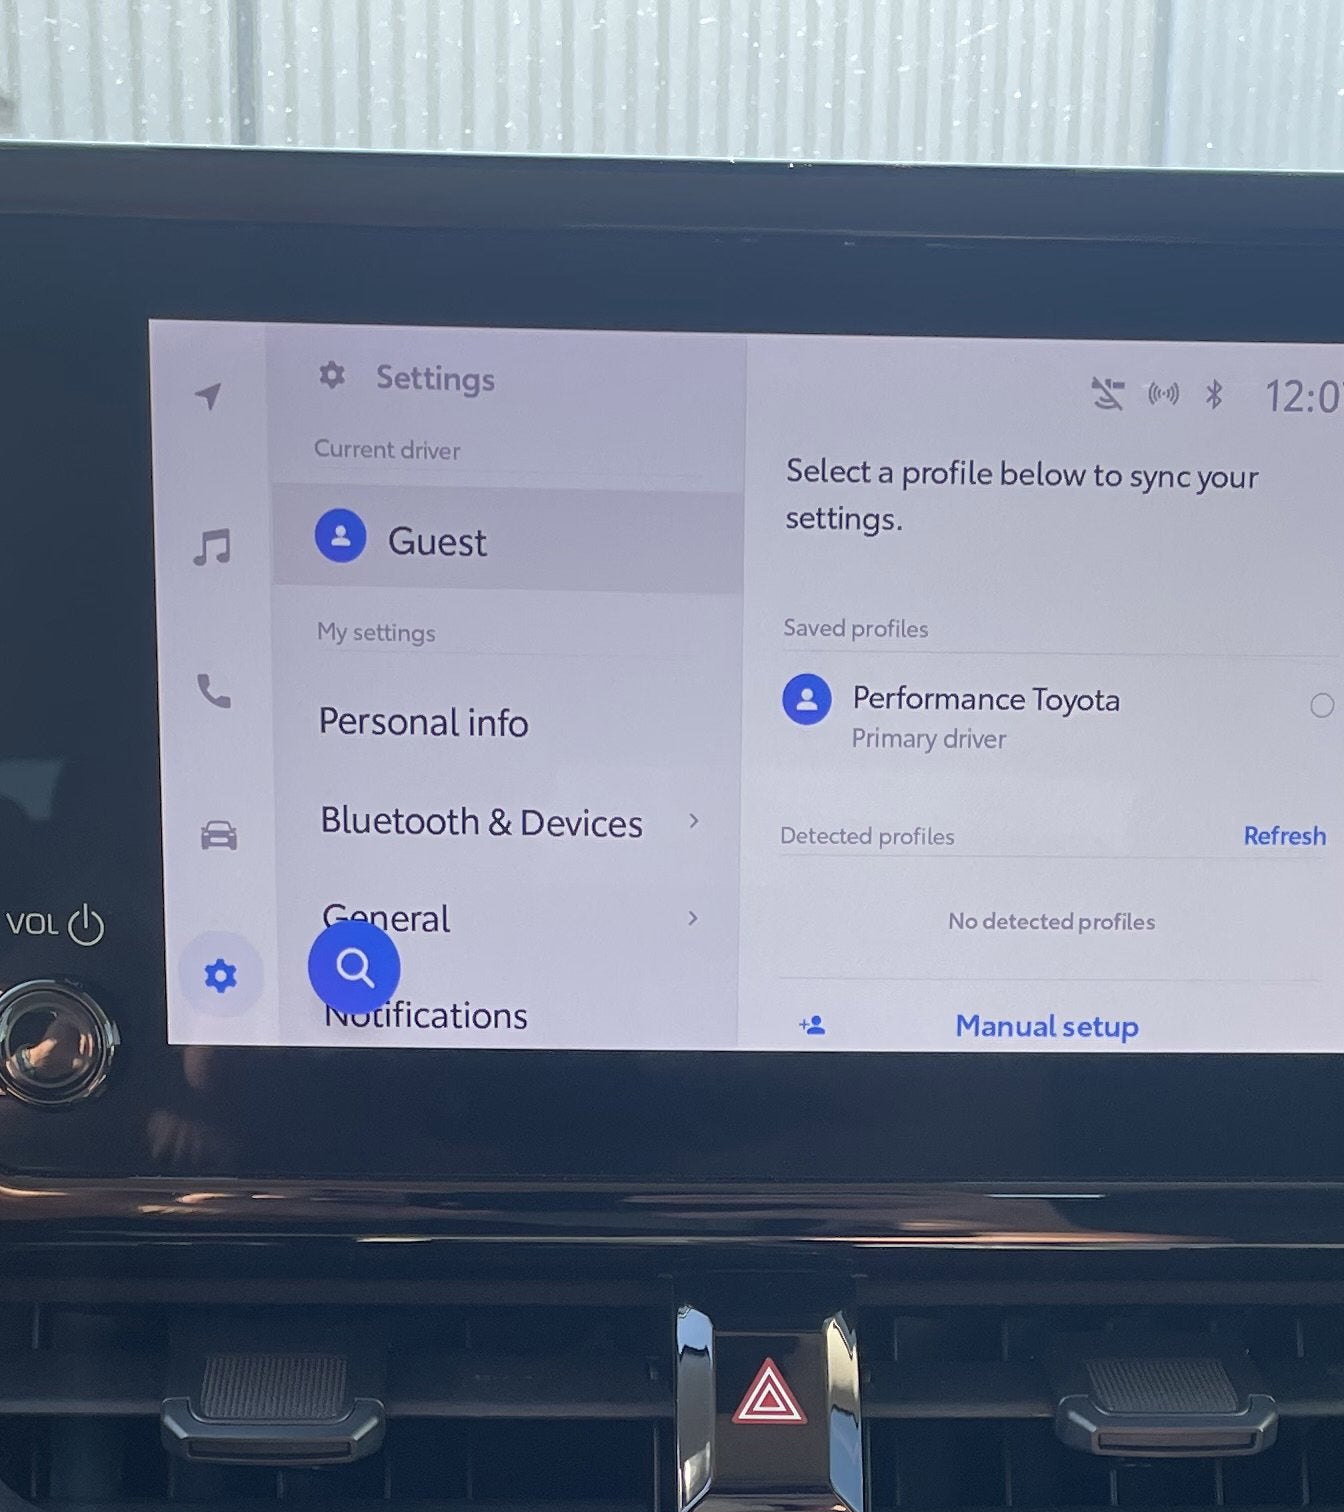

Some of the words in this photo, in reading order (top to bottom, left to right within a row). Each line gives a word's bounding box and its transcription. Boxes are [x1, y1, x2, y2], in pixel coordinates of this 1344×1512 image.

[377, 364, 495, 398] Settings
[314, 438, 396, 459] Current
[400, 439, 461, 460] driver
[787, 457, 871, 483] Select
[879, 467, 893, 483] a
[903, 460, 992, 491] profile
[1001, 460, 1087, 486] below
[1094, 465, 1122, 487] to
[1131, 470, 1191, 495] sync
[1196, 471, 1259, 495] your
[787, 506, 902, 537] settings.
[389, 526, 487, 557] Guest
[318, 622, 347, 646] My
[354, 624, 435, 647] settings
[784, 618, 845, 637] Saved
[852, 618, 928, 642] profiles
[855, 684, 1025, 710] Performance
[1032, 687, 1119, 718] Toyota
[321, 707, 459, 736] Personal
[469, 708, 528, 737] info
[853, 727, 938, 754] Primary
[944, 727, 1007, 749] driver
[322, 805, 479, 835] Bluetooth
[488, 808, 512, 836] &
[522, 808, 642, 838] Devices
[1245, 825, 1326, 845] Refresh
[781, 826, 872, 845] Detected
[879, 827, 954, 850] profiles
[6, 912, 59, 935] VOL
[949, 912, 978, 929] No
[983, 911, 1074, 930] detected
[1078, 912, 1155, 935] profiles
[957, 1013, 1057, 1037] Manual
[1062, 1017, 1139, 1044] setup
